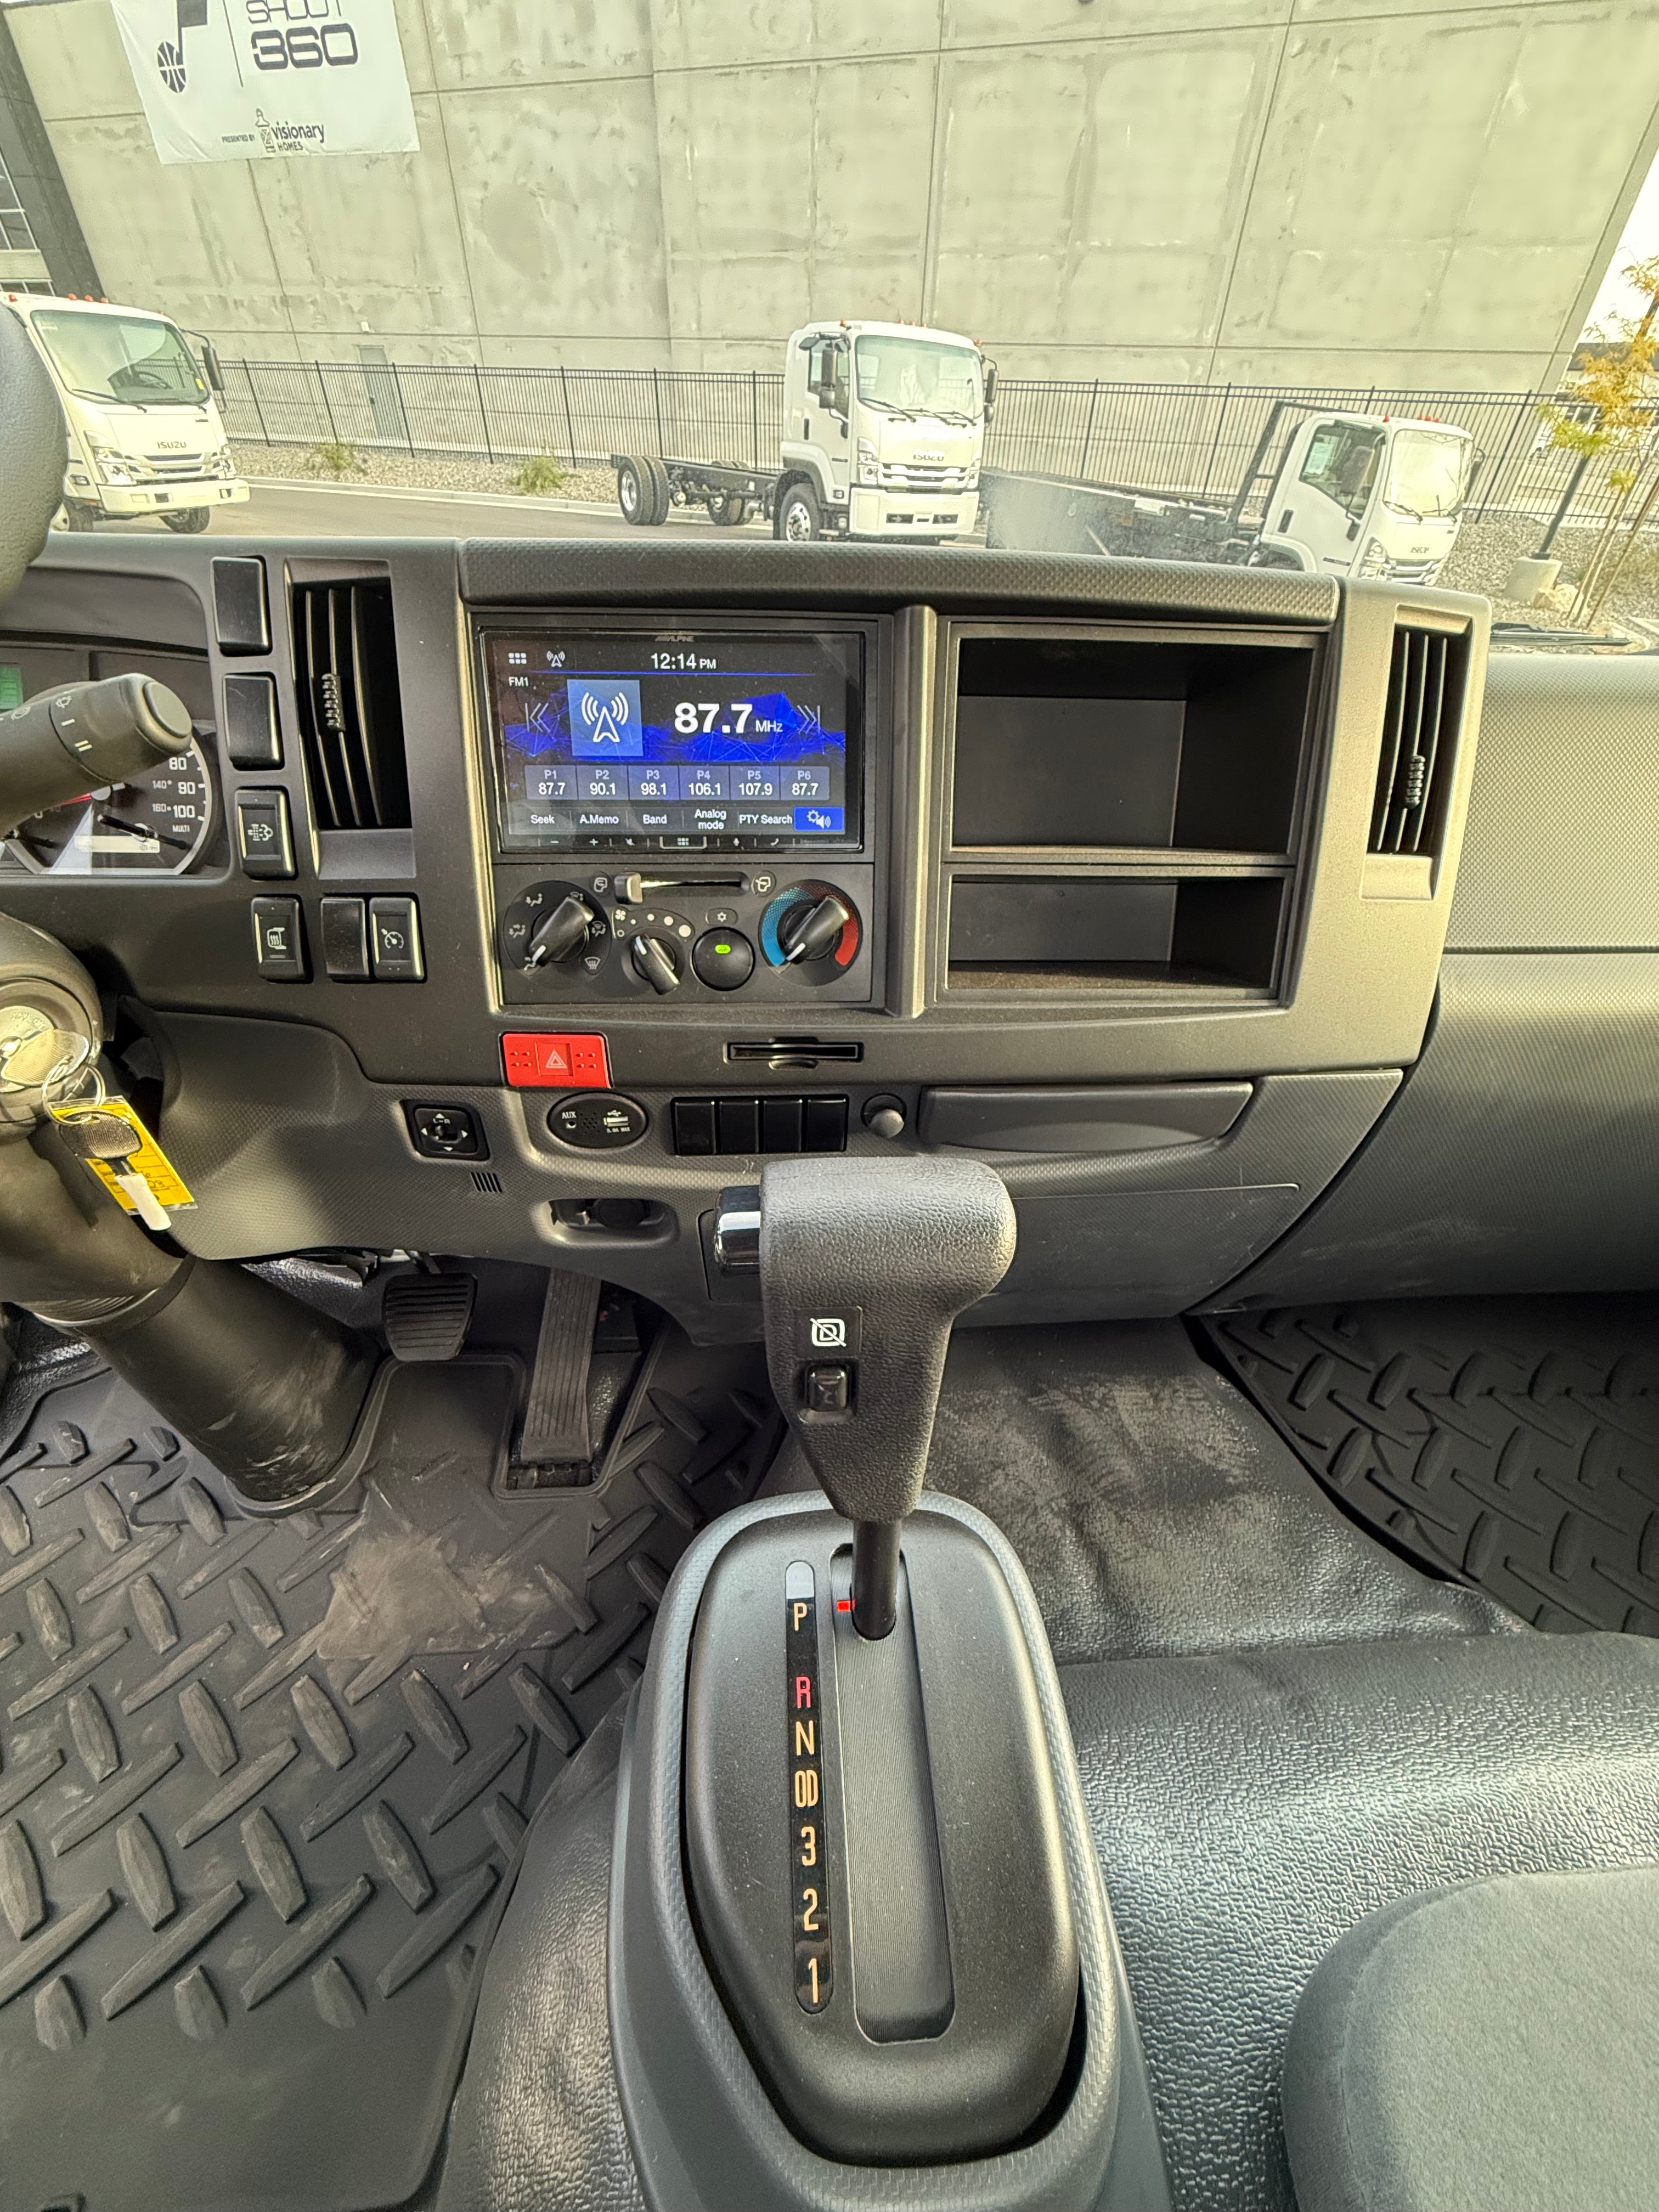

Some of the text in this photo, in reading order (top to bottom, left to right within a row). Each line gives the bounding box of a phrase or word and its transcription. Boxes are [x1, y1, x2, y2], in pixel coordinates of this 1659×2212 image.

[251, 23, 358, 70] 360
[271, 121, 325, 143] visionary
[277, 141, 303, 151] HOMES
[651, 653, 716, 669] 12:14 PM
[509, 676, 529, 687] FM1
[674, 702, 783, 733] 87.7 MHz
[169, 757, 187, 770] 80
[544, 769, 557, 780] P1
[595, 770, 610, 780] P2
[646, 770, 660, 780] P3
[697, 770, 711, 780] P4
[747, 770, 761, 780] P5
[797, 770, 811, 780] P6
[153, 780, 167, 789] 140
[178, 782, 196, 794] 90
[538, 782, 566, 795] 87.7
[590, 782, 616, 795] 90.1
[640, 782, 667, 795] 98.1
[688, 782, 721, 795] 106.1
[738, 783, 772, 795] 107.9
[791, 783, 819, 795] 87.7
[173, 805, 195, 818] 100
[694, 809, 726, 820] Analog
[531, 814, 555, 824] Seek
[579, 814, 619, 824] A.Memo
[642, 814, 667, 825] Band
[698, 820, 724, 830] mode
[739, 814, 793, 824] PTY Search
[562, 1111, 577, 1119] AUX
[793, 1602, 808, 1631] P
[795, 1677, 811, 1708] R
[795, 1721, 815, 1756] N
[801, 1826, 816, 1866] 3
[803, 1889, 819, 1931] 2
[808, 1958, 819, 2004] 1
